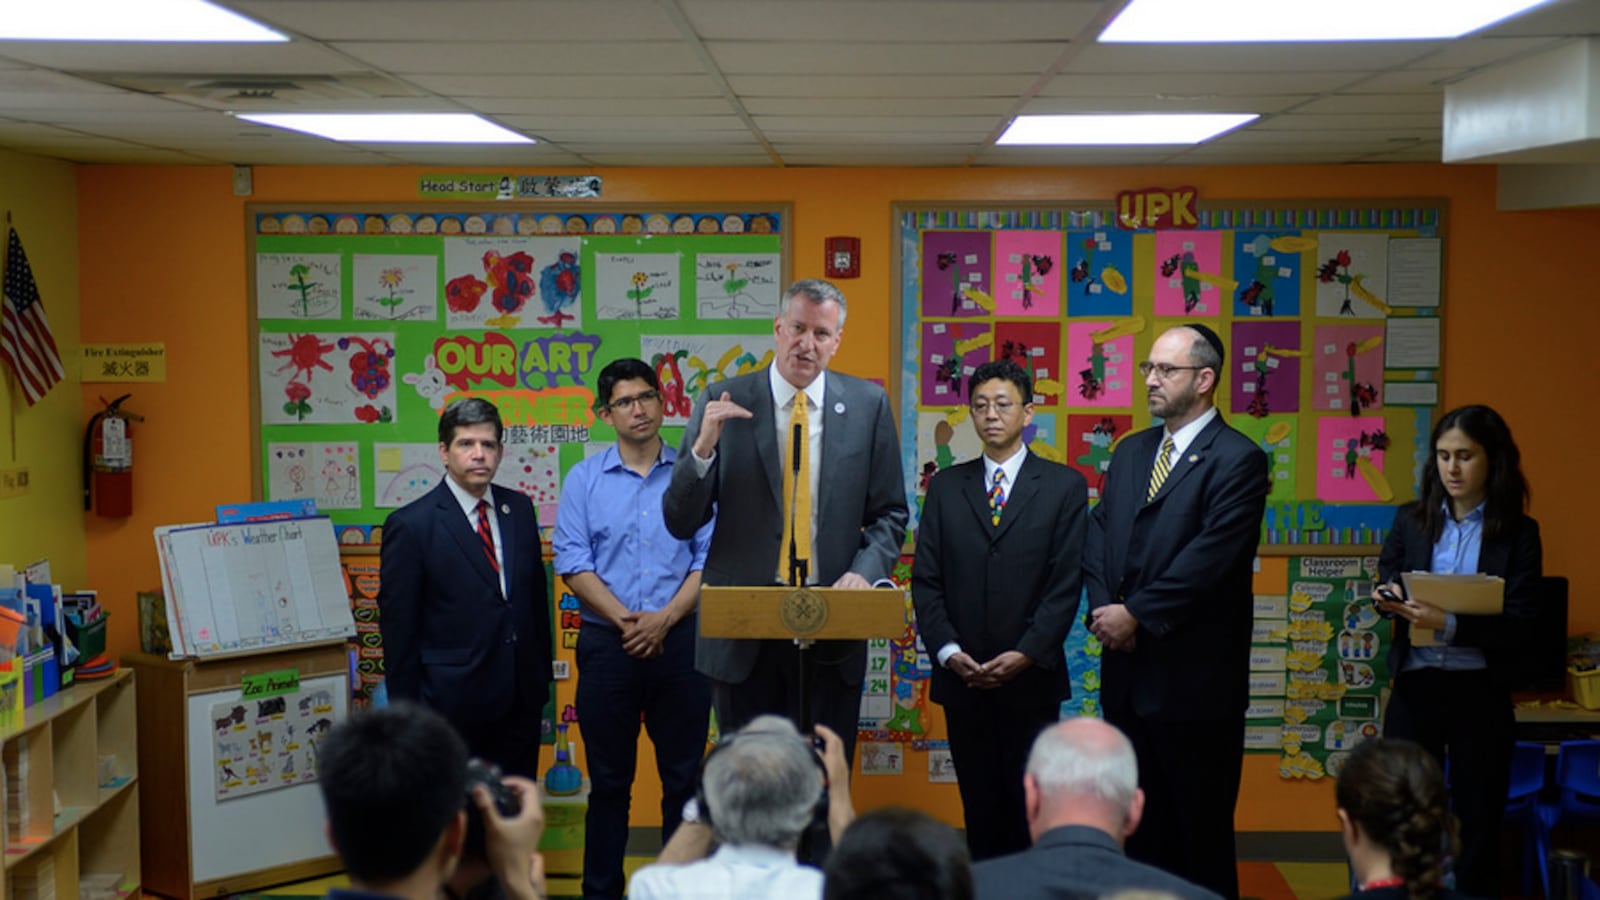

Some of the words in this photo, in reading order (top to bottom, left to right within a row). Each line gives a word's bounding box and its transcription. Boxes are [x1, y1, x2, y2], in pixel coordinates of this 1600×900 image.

[420, 179, 453, 192] Head
[458, 179, 495, 192] Start
[1120, 191, 1198, 228] UPK
[85, 347, 104, 357] Fire
[107, 346, 164, 359] Extinguisher
[437, 342, 515, 376] OUR
[522, 341, 594, 374] ART
[102, 361, 150, 377] 滅火器
[1303, 558, 1358, 567] Classroom
[1308, 567, 1345, 576] Helper
[562, 611, 583, 629] Fe
[871, 657, 887, 671] 17
[243, 682, 263, 696] Zoo
[266, 676, 299, 692] Animals
[870, 679, 887, 693] 24
